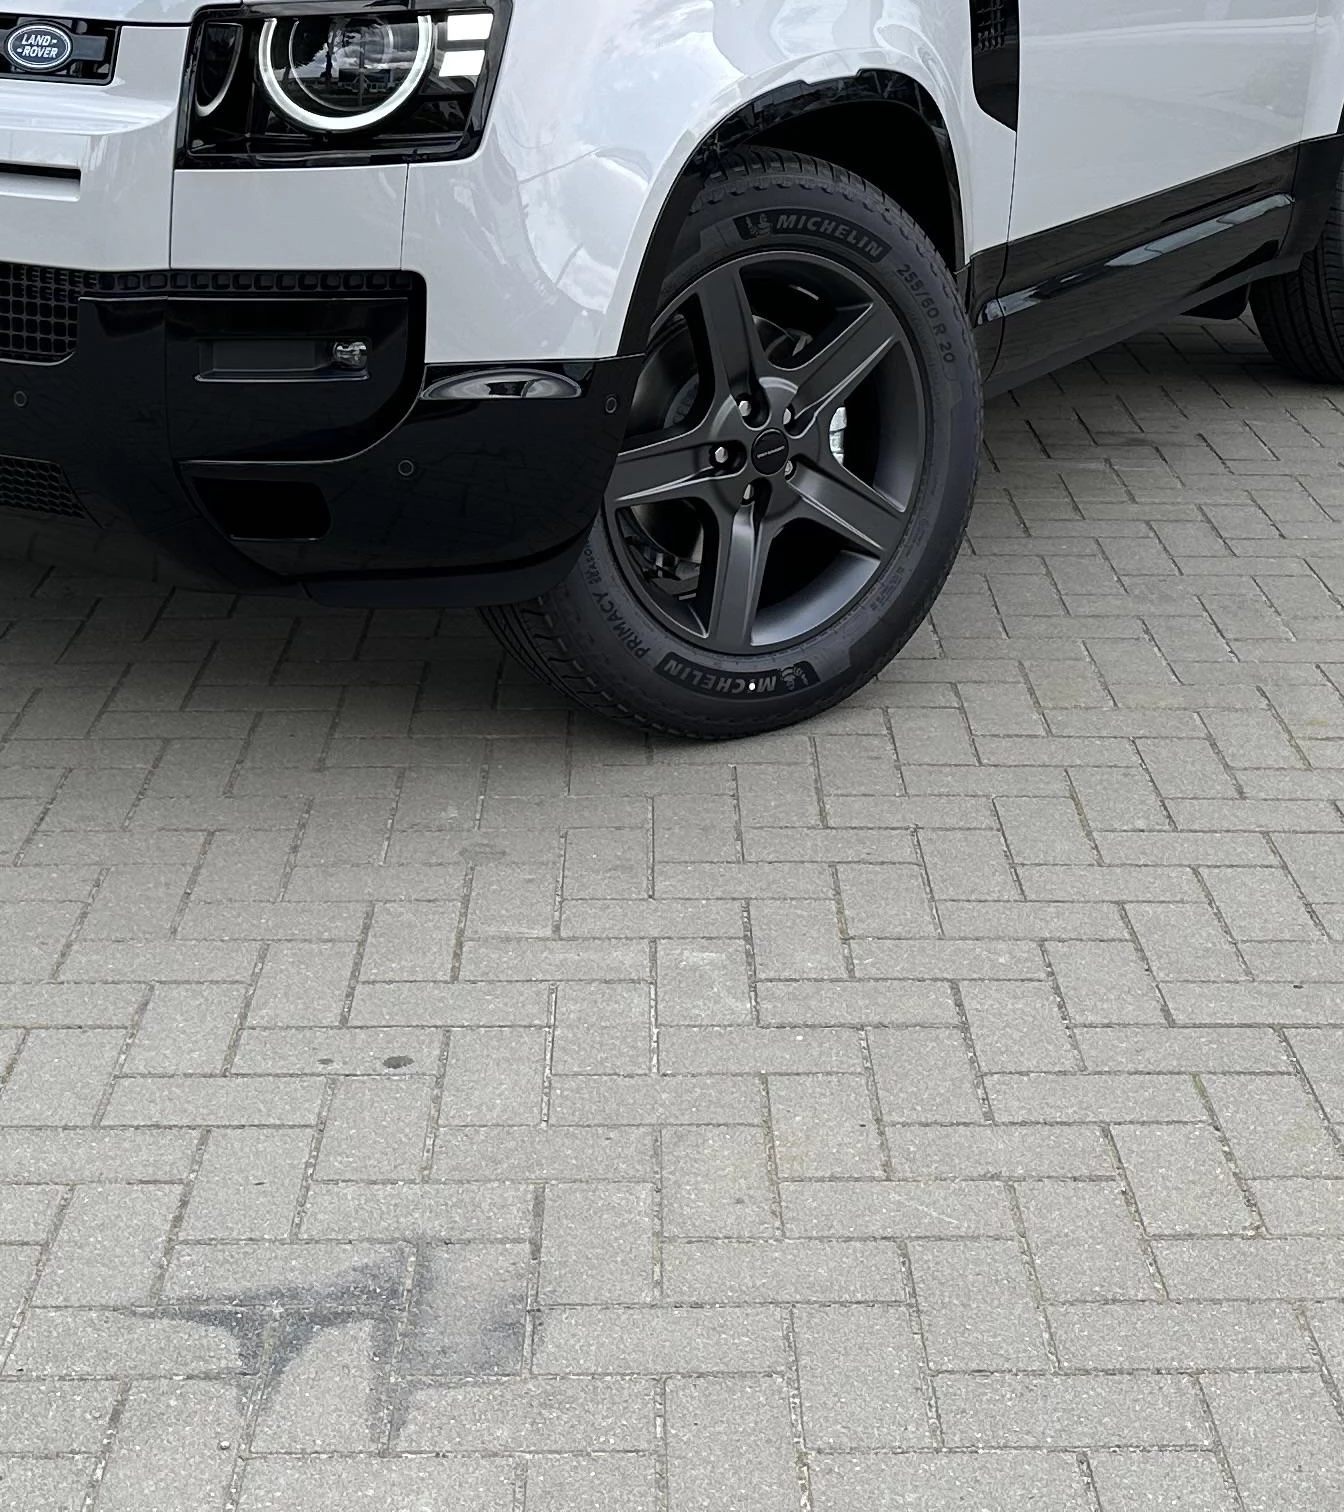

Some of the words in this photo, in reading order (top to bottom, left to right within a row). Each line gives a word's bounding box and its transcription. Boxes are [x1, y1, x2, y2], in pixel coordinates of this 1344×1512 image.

[776, 214, 883, 257] MICHELIN
[896, 263, 940, 319] 255/60
[933, 323, 948, 336] R
[939, 341, 956, 363] 20
[591, 592, 651, 659] PRIMACY
[663, 659, 777, 694] MCHELIN
